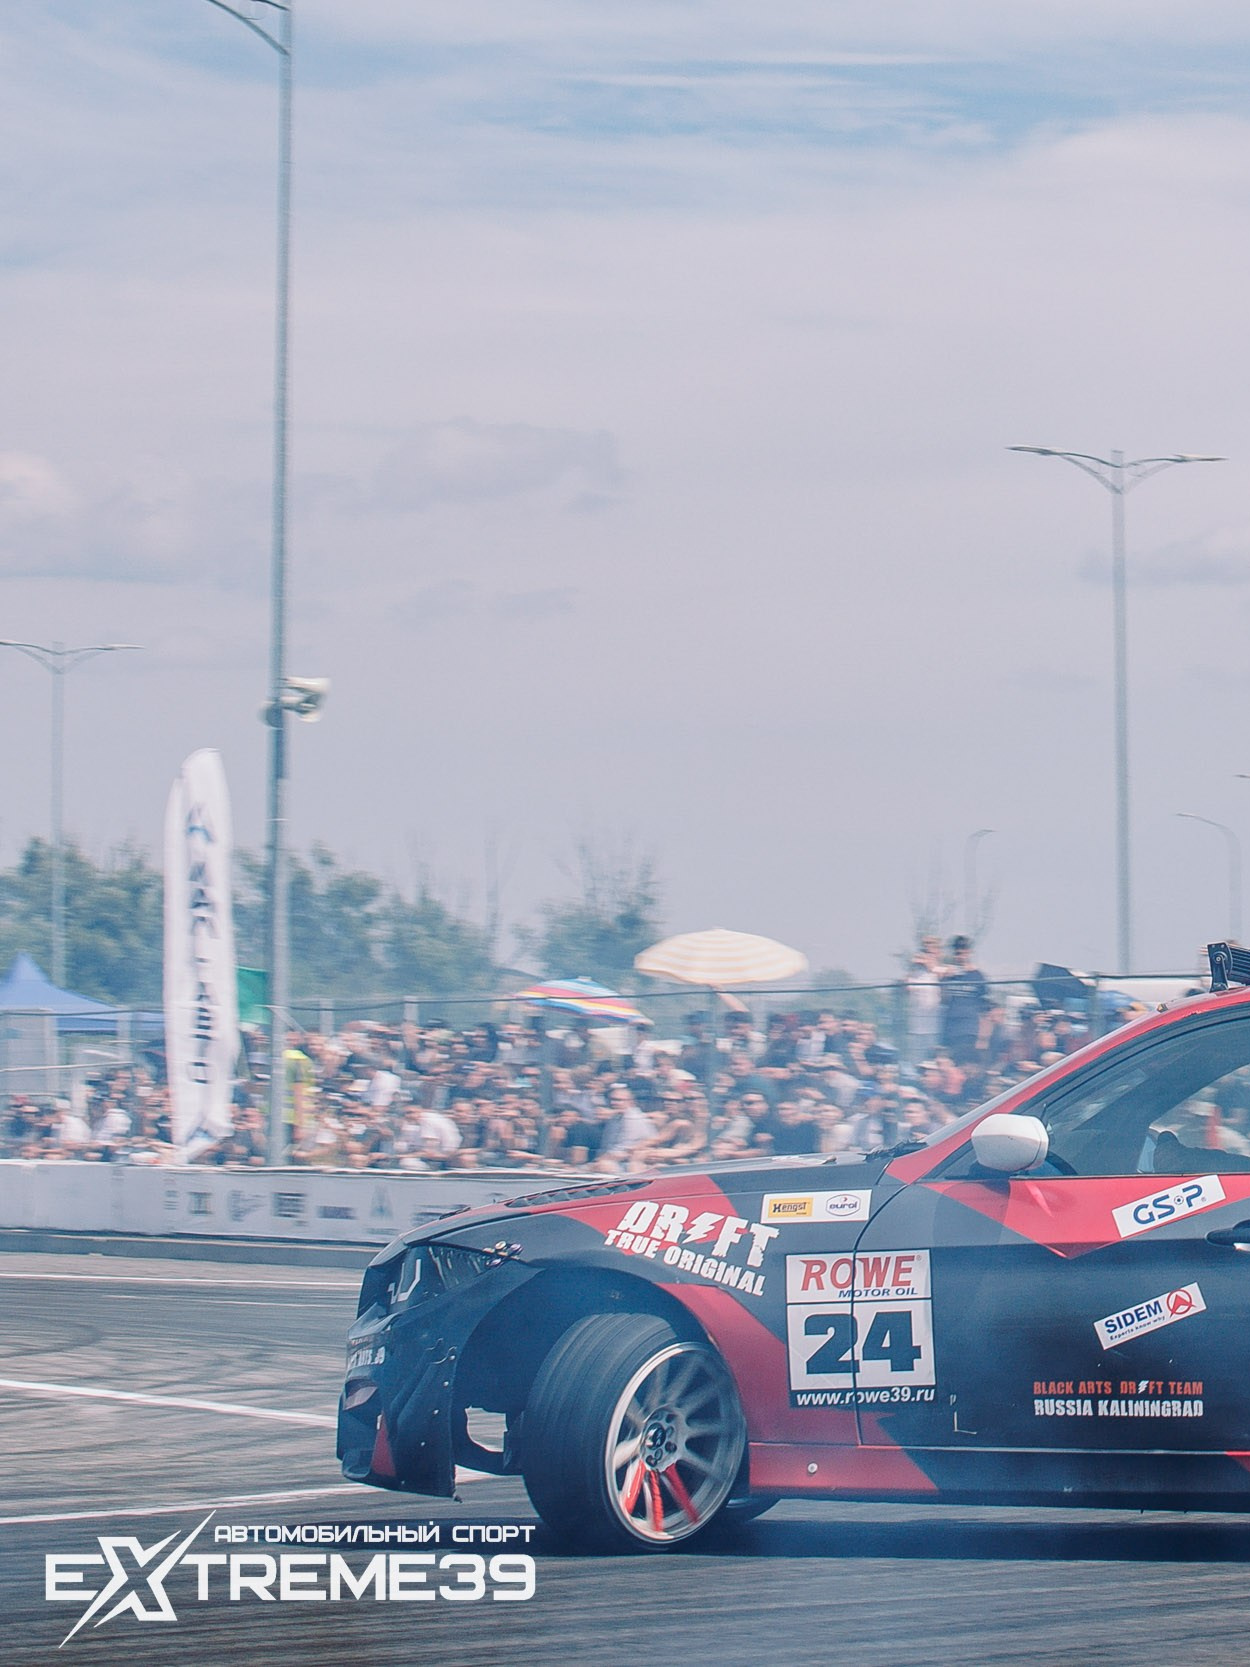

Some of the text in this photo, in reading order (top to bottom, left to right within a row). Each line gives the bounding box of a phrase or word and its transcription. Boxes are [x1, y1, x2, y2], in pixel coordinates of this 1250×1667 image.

[604, 1229, 766, 1296] TRUE ORIGINAL
[800, 1255, 916, 1291] ROWE
[838, 1287, 918, 1298] MOTOR OIL
[1104, 1300, 1164, 1334] SIDEM
[804, 1310, 922, 1374] 24
[796, 1386, 936, 1406] www.rowe39.ru
[1033, 1381, 1075, 1395] BLACK
[1078, 1381, 1112, 1394] ARTS
[1168, 1381, 1203, 1394] TEAM
[1034, 1399, 1204, 1417] RUSSIA KALININGRAD
